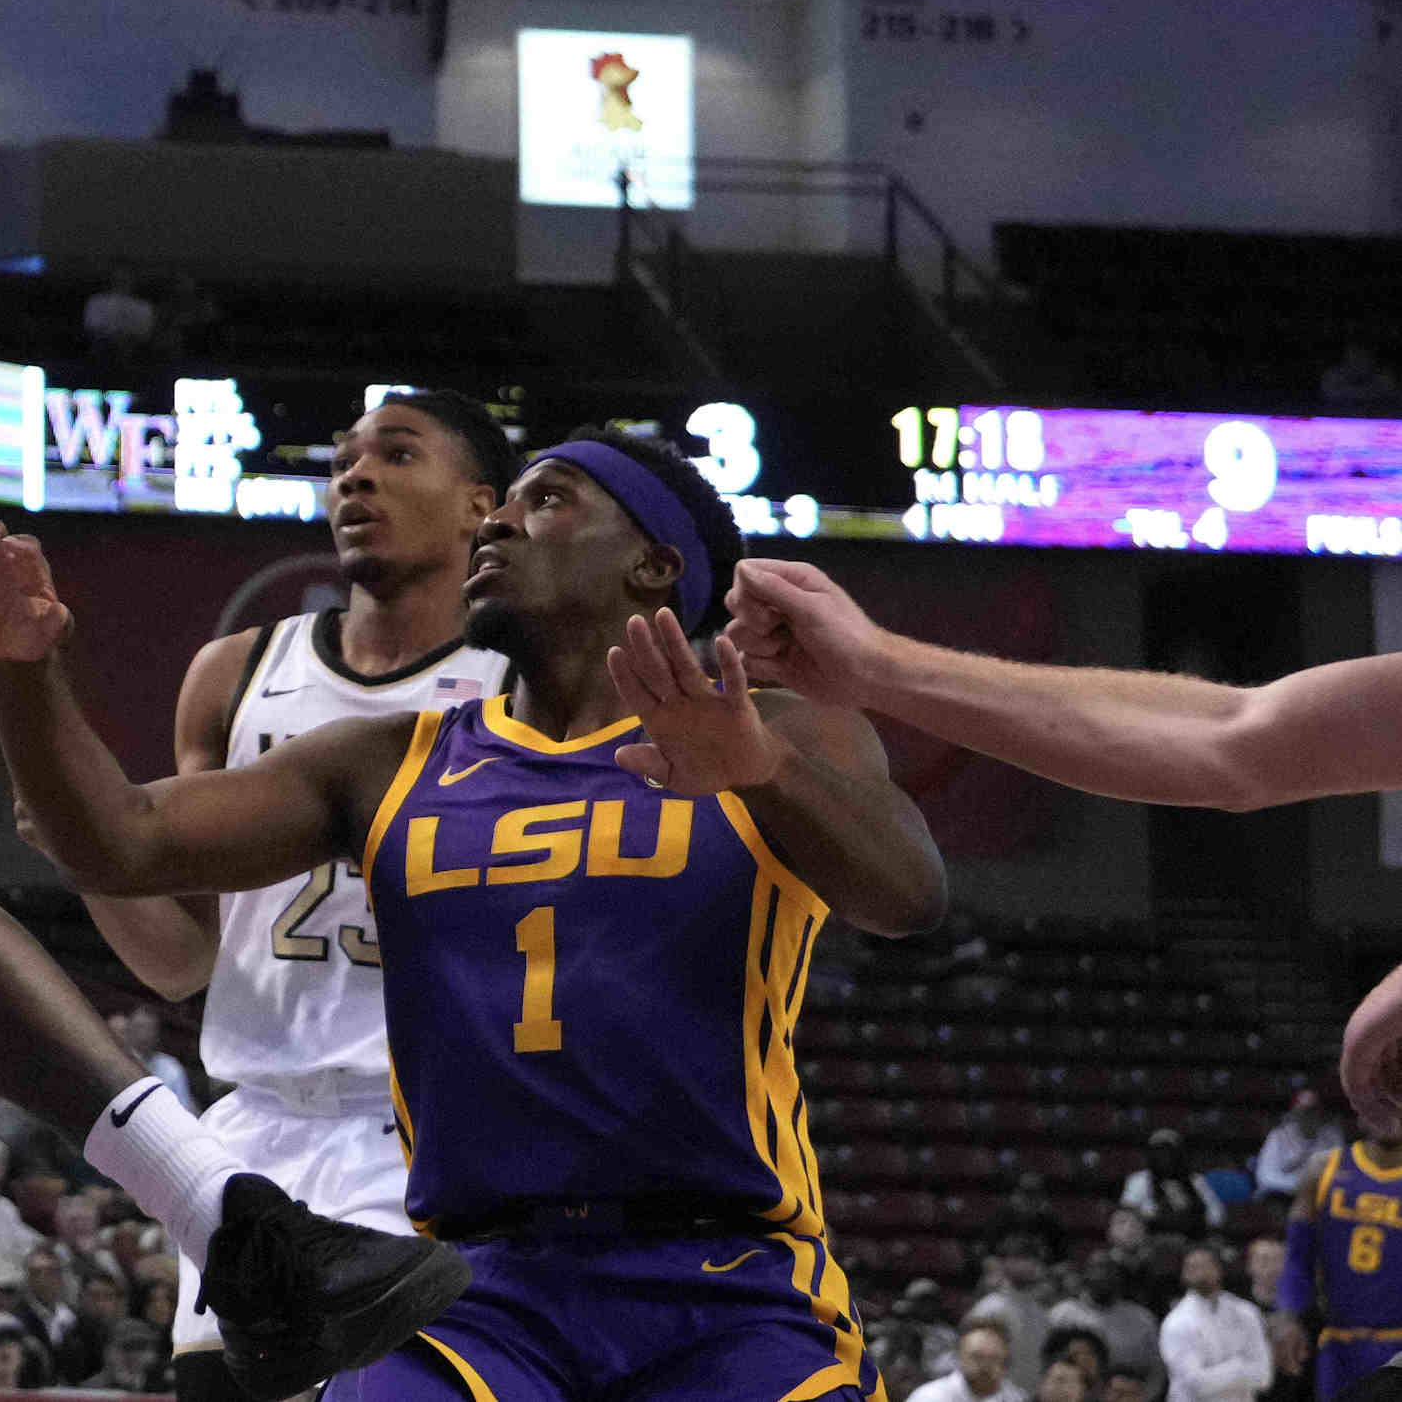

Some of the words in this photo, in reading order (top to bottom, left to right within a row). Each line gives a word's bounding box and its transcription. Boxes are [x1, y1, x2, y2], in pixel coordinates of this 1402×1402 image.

[891, 406, 1045, 472] 17:18
[1204, 421, 1278, 512] 9
[405, 799, 694, 898] LSU
[514, 906, 563, 1054] 1
[1348, 1225, 1385, 1274] 6
